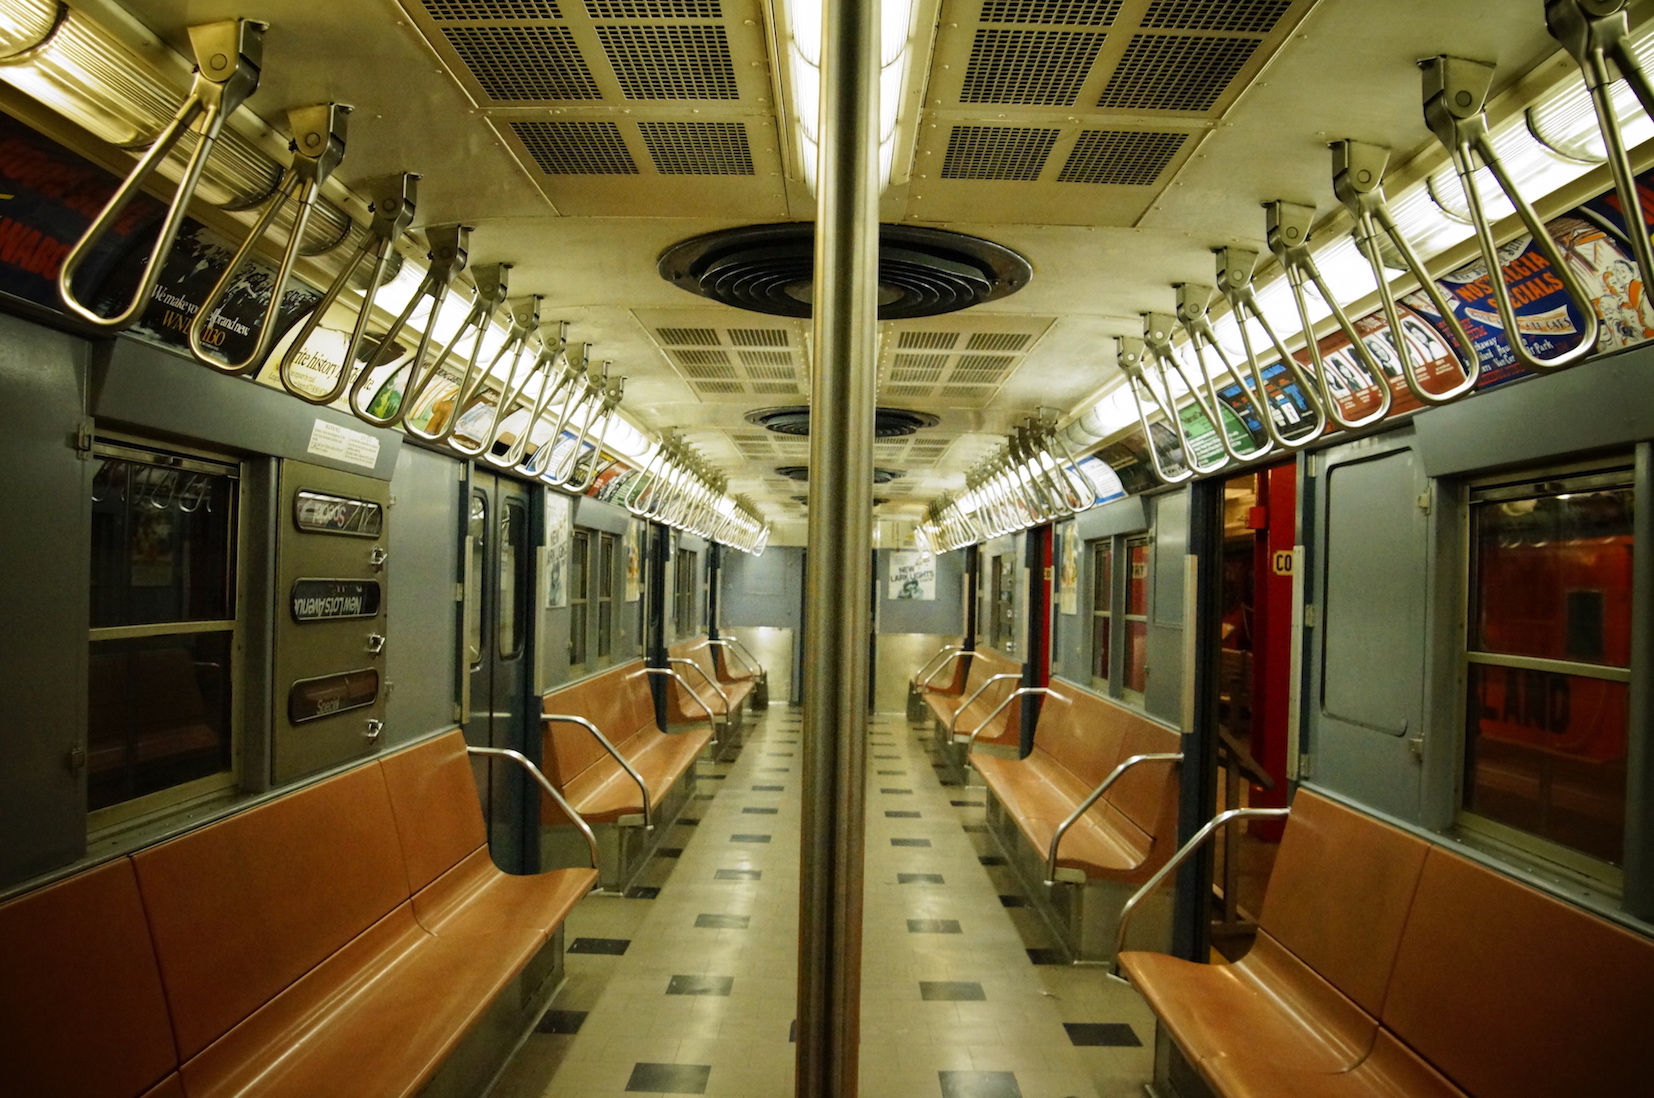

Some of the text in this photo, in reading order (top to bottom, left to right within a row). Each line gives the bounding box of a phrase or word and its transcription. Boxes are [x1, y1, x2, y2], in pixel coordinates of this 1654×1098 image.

[1455, 251, 1550, 303] NOSALGIA
[163, 294, 188, 311] make
[1488, 272, 1565, 314] SECIALS
[1533, 339, 1554, 355] Park
[307, 351, 340, 380] history
[325, 596, 344, 616] Lots
[343, 596, 362, 616] New
